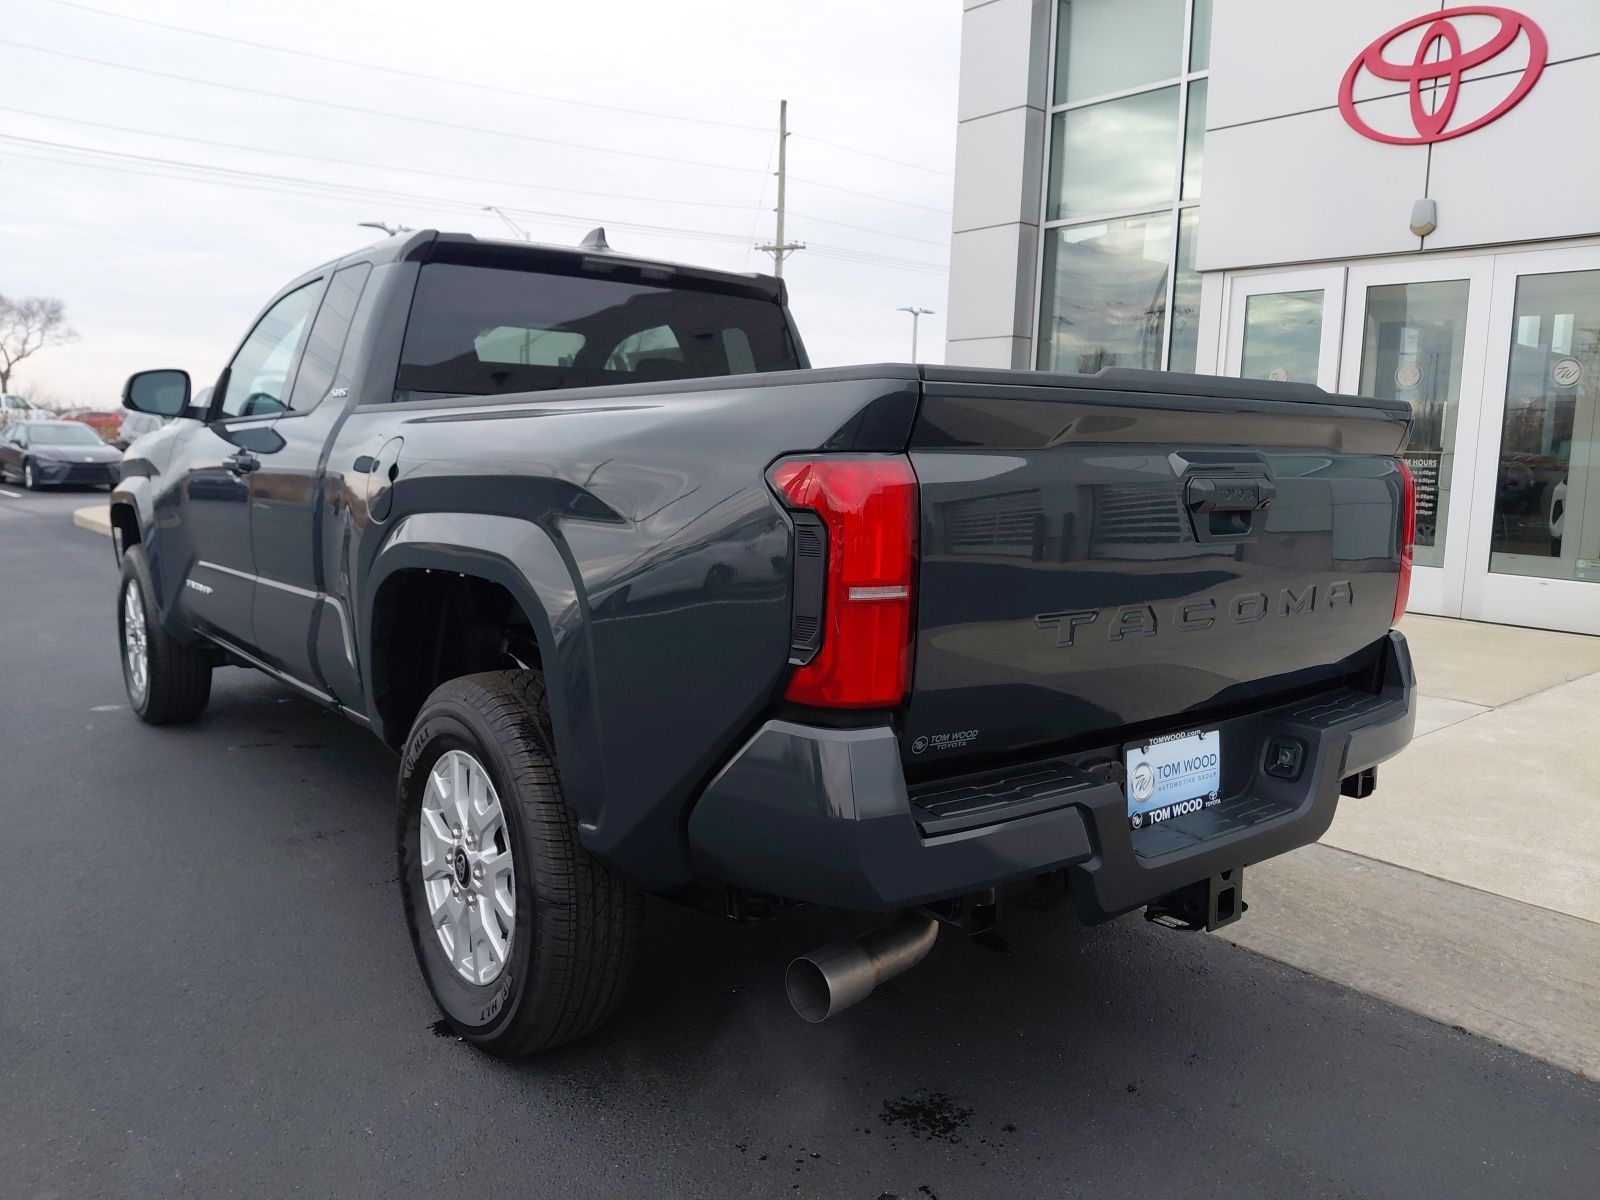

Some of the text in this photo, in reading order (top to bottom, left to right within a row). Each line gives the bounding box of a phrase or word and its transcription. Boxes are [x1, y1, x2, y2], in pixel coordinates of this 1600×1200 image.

[1412, 458, 1437, 468] HOURS
[1034, 580, 1354, 648] TACOMA
[931, 729, 979, 744] TOM WOOD
[1149, 730, 1201, 745] TOMWOOD.com
[937, 741, 966, 750] TOYOTA
[1157, 753, 1217, 780] TOM WOOD
[1158, 772, 1217, 791] AUTOMOTIVE GROUP
[1205, 798, 1222, 808] TOYOTA
[1149, 798, 1203, 825] TOM WOOD
